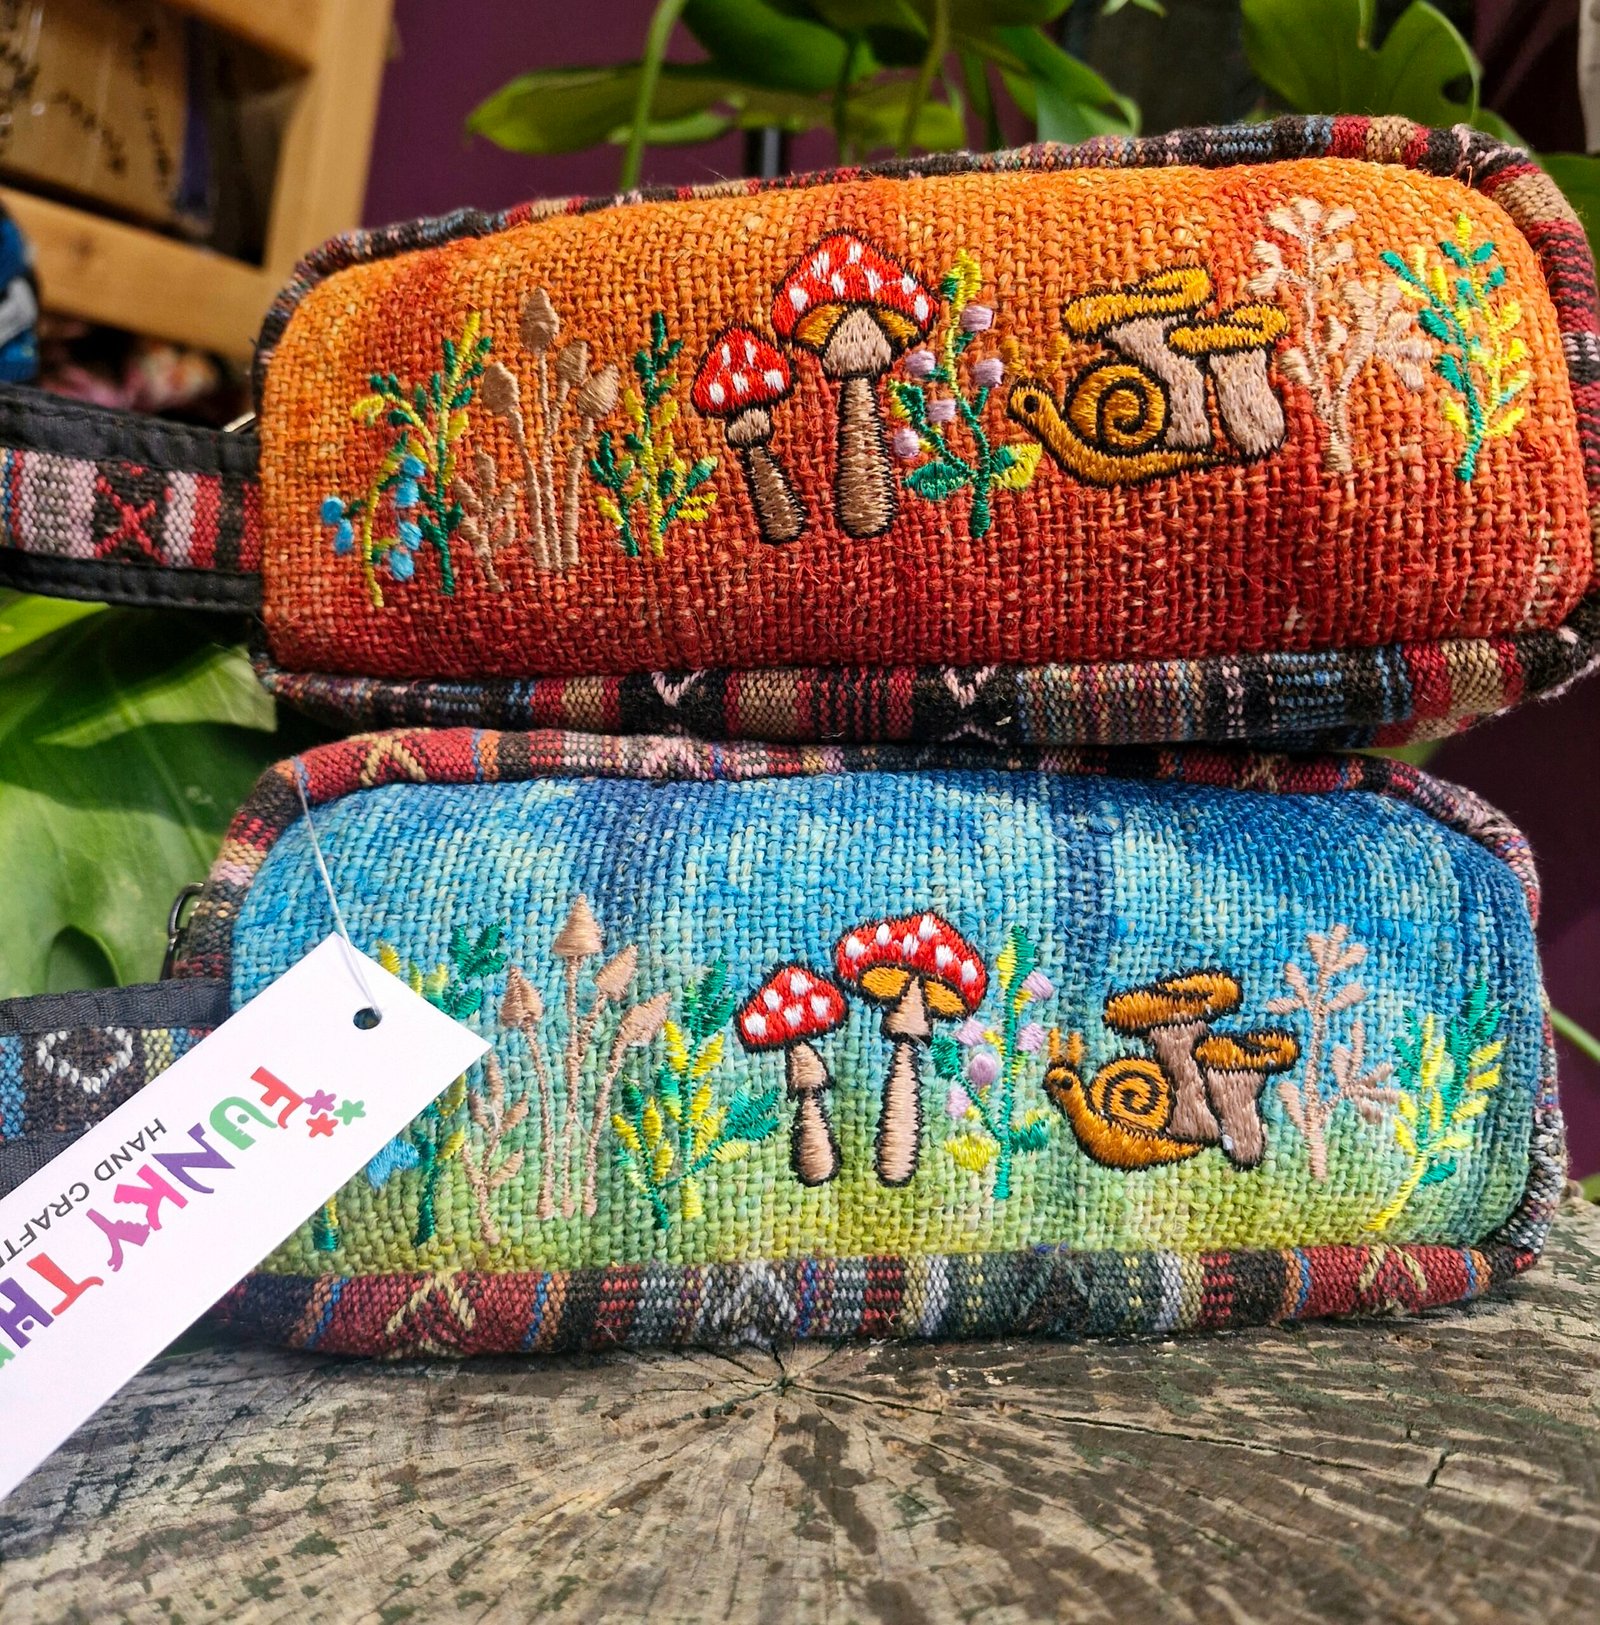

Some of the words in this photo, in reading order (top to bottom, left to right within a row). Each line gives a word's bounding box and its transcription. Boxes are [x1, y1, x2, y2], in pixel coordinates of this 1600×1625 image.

[85, 1066, 304, 1272] FUNKY
[94, 1117, 168, 1182] HAND
[0, 1182, 90, 1268] CRAFT
[0, 1252, 104, 1368] TH
